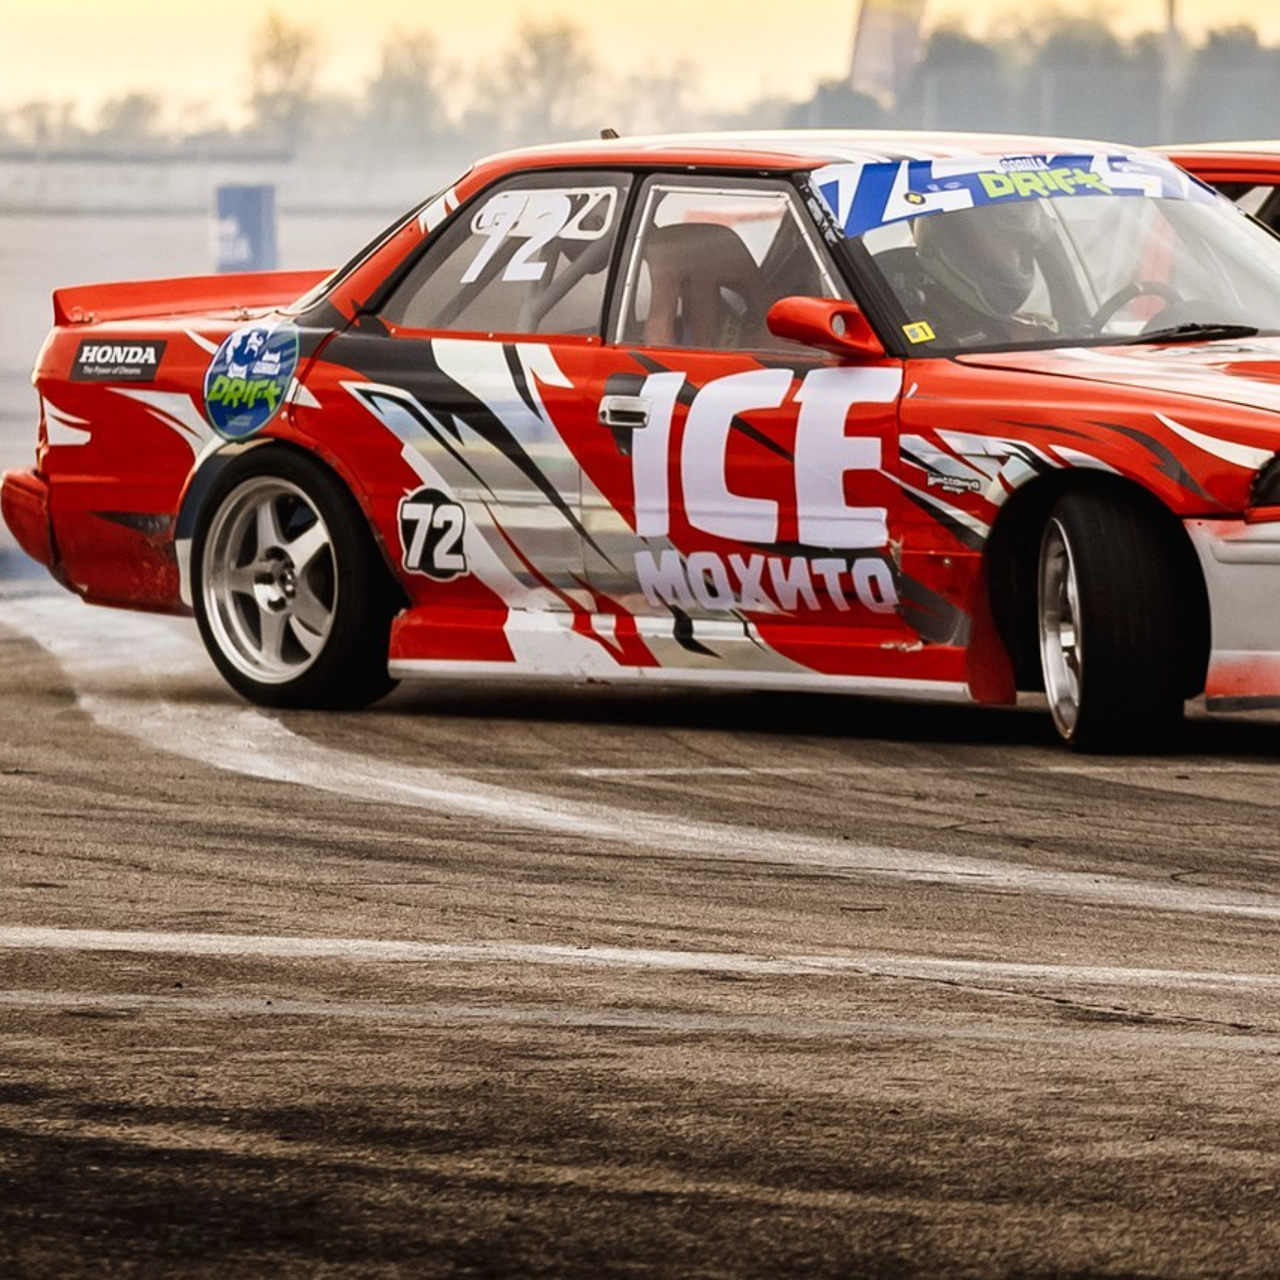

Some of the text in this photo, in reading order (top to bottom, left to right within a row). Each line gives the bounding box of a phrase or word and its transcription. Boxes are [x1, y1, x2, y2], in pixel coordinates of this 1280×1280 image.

[978, 168, 1113, 198] DRIFT
[460, 194, 571, 283] 72
[79, 346, 156, 364] HONDA
[207, 376, 281, 412] DRIFT
[632, 367, 902, 548] ICE
[402, 502, 466, 570] 72
[634, 550, 899, 613] МОХИТО
